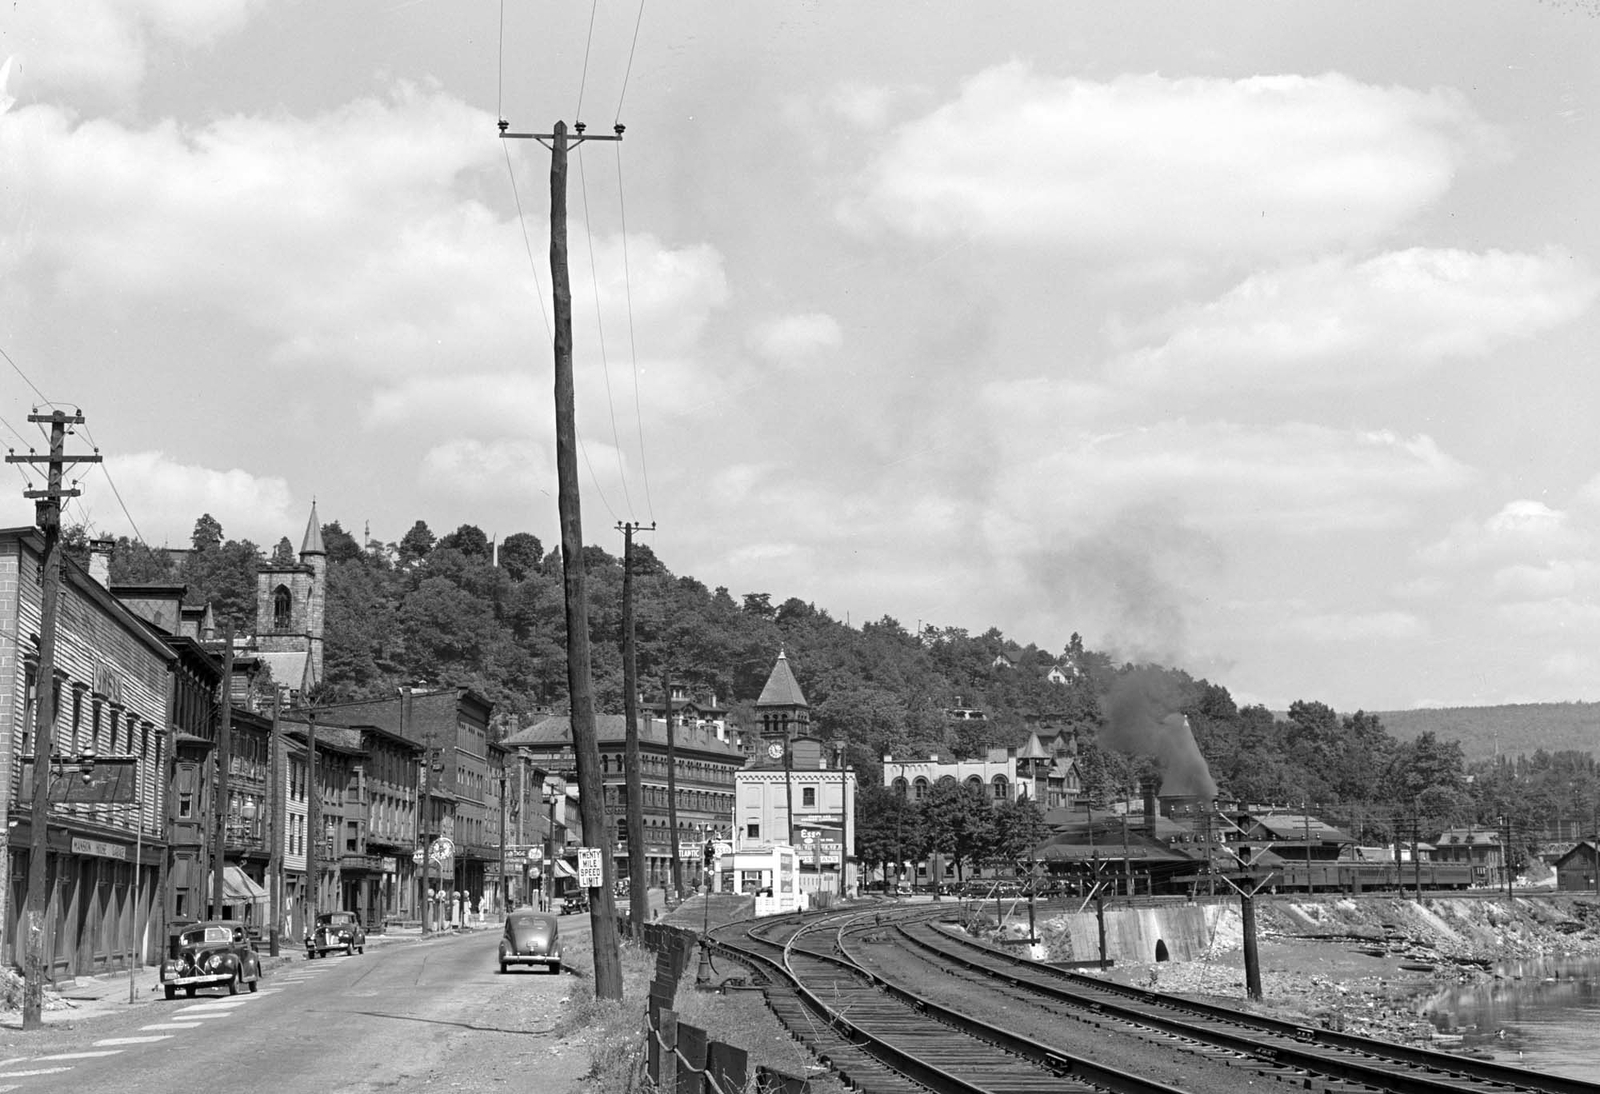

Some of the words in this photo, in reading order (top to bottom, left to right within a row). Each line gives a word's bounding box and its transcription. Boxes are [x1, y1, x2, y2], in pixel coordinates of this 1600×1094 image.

[800, 829, 821, 838] Esso
[579, 851, 601, 859] TWENTY
[679, 849, 700, 858] TLANTIC
[582, 860, 598, 868] MILE
[580, 868, 600, 876] SPEED
[582, 877, 599, 886] LIMIT
